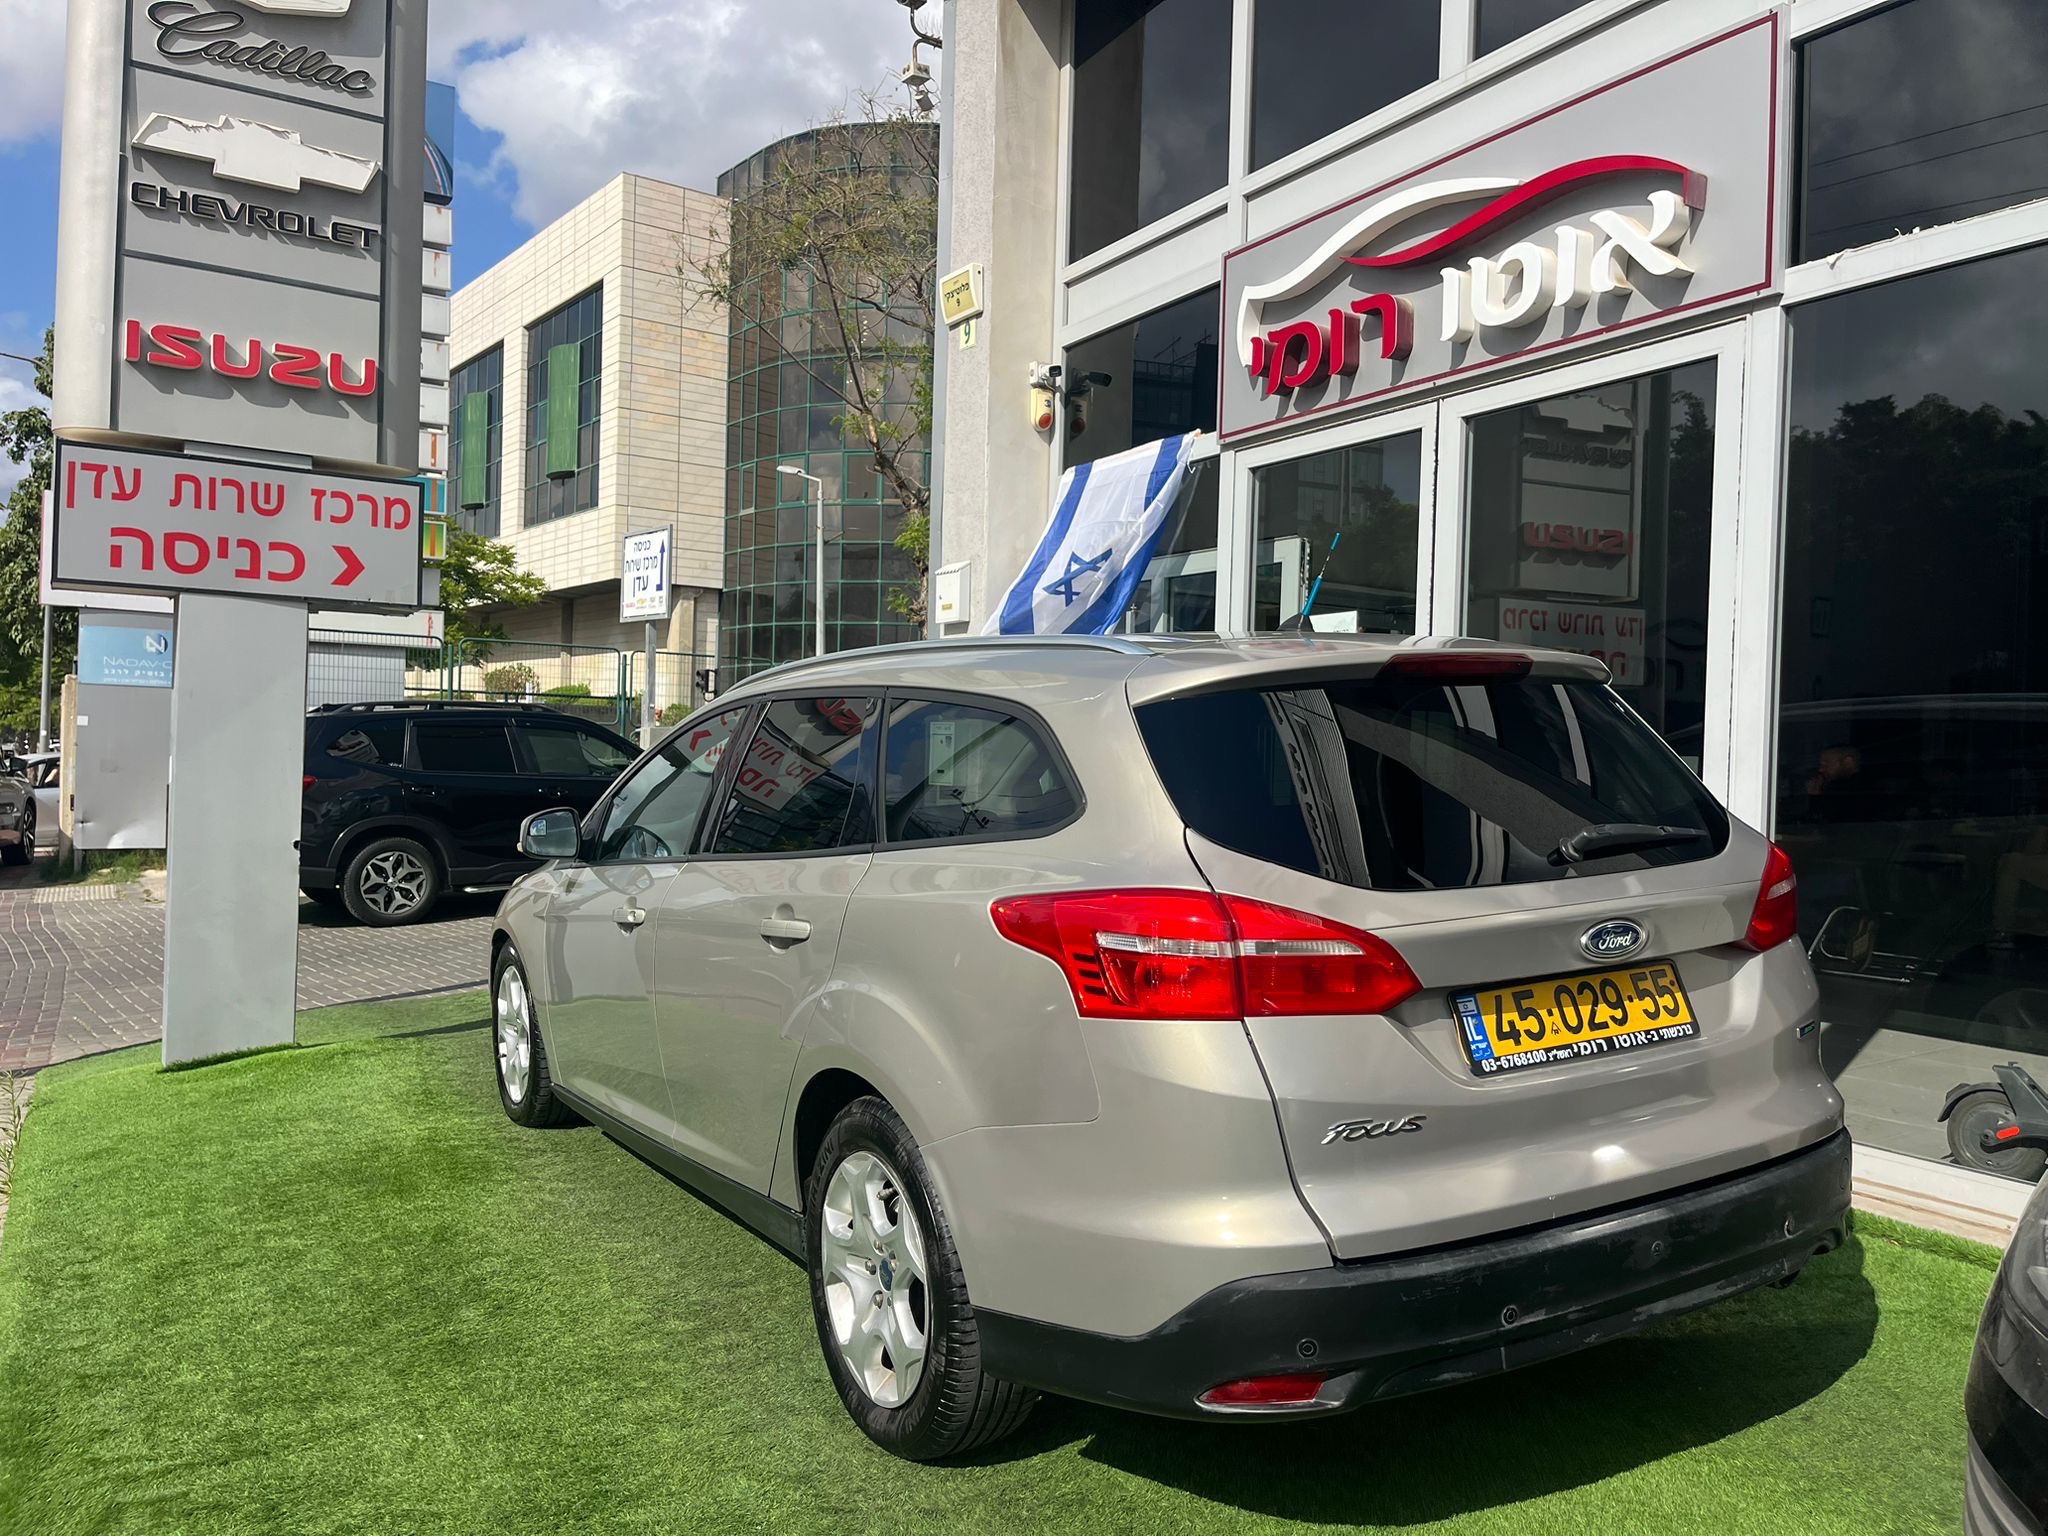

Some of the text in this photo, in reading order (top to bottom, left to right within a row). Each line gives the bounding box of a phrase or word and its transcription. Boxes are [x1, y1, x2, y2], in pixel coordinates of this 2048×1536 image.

[146, 0, 374, 93] Cadillac
[131, 182, 380, 249] CHEVROLET
[1250, 190, 1693, 396] אוטו רומי
[964, 320, 971, 344] 9
[124, 318, 378, 396] ISUZU
[66, 461, 412, 530] מרכז שרות עדן
[109, 526, 307, 583] כניסה
[634, 540, 651, 553] כניסה
[643, 555, 658, 571] מרכז
[633, 575, 649, 598] עדן
[1598, 927, 1633, 949] Ford
[1463, 1016, 1483, 1042] IL
[1614, 1032, 1660, 1049] ב-אוטו
[1660, 1024, 1693, 1040] נרכשתי
[1572, 1039, 1608, 1056] רומי
[1481, 1049, 1547, 1073] 03-6768100
